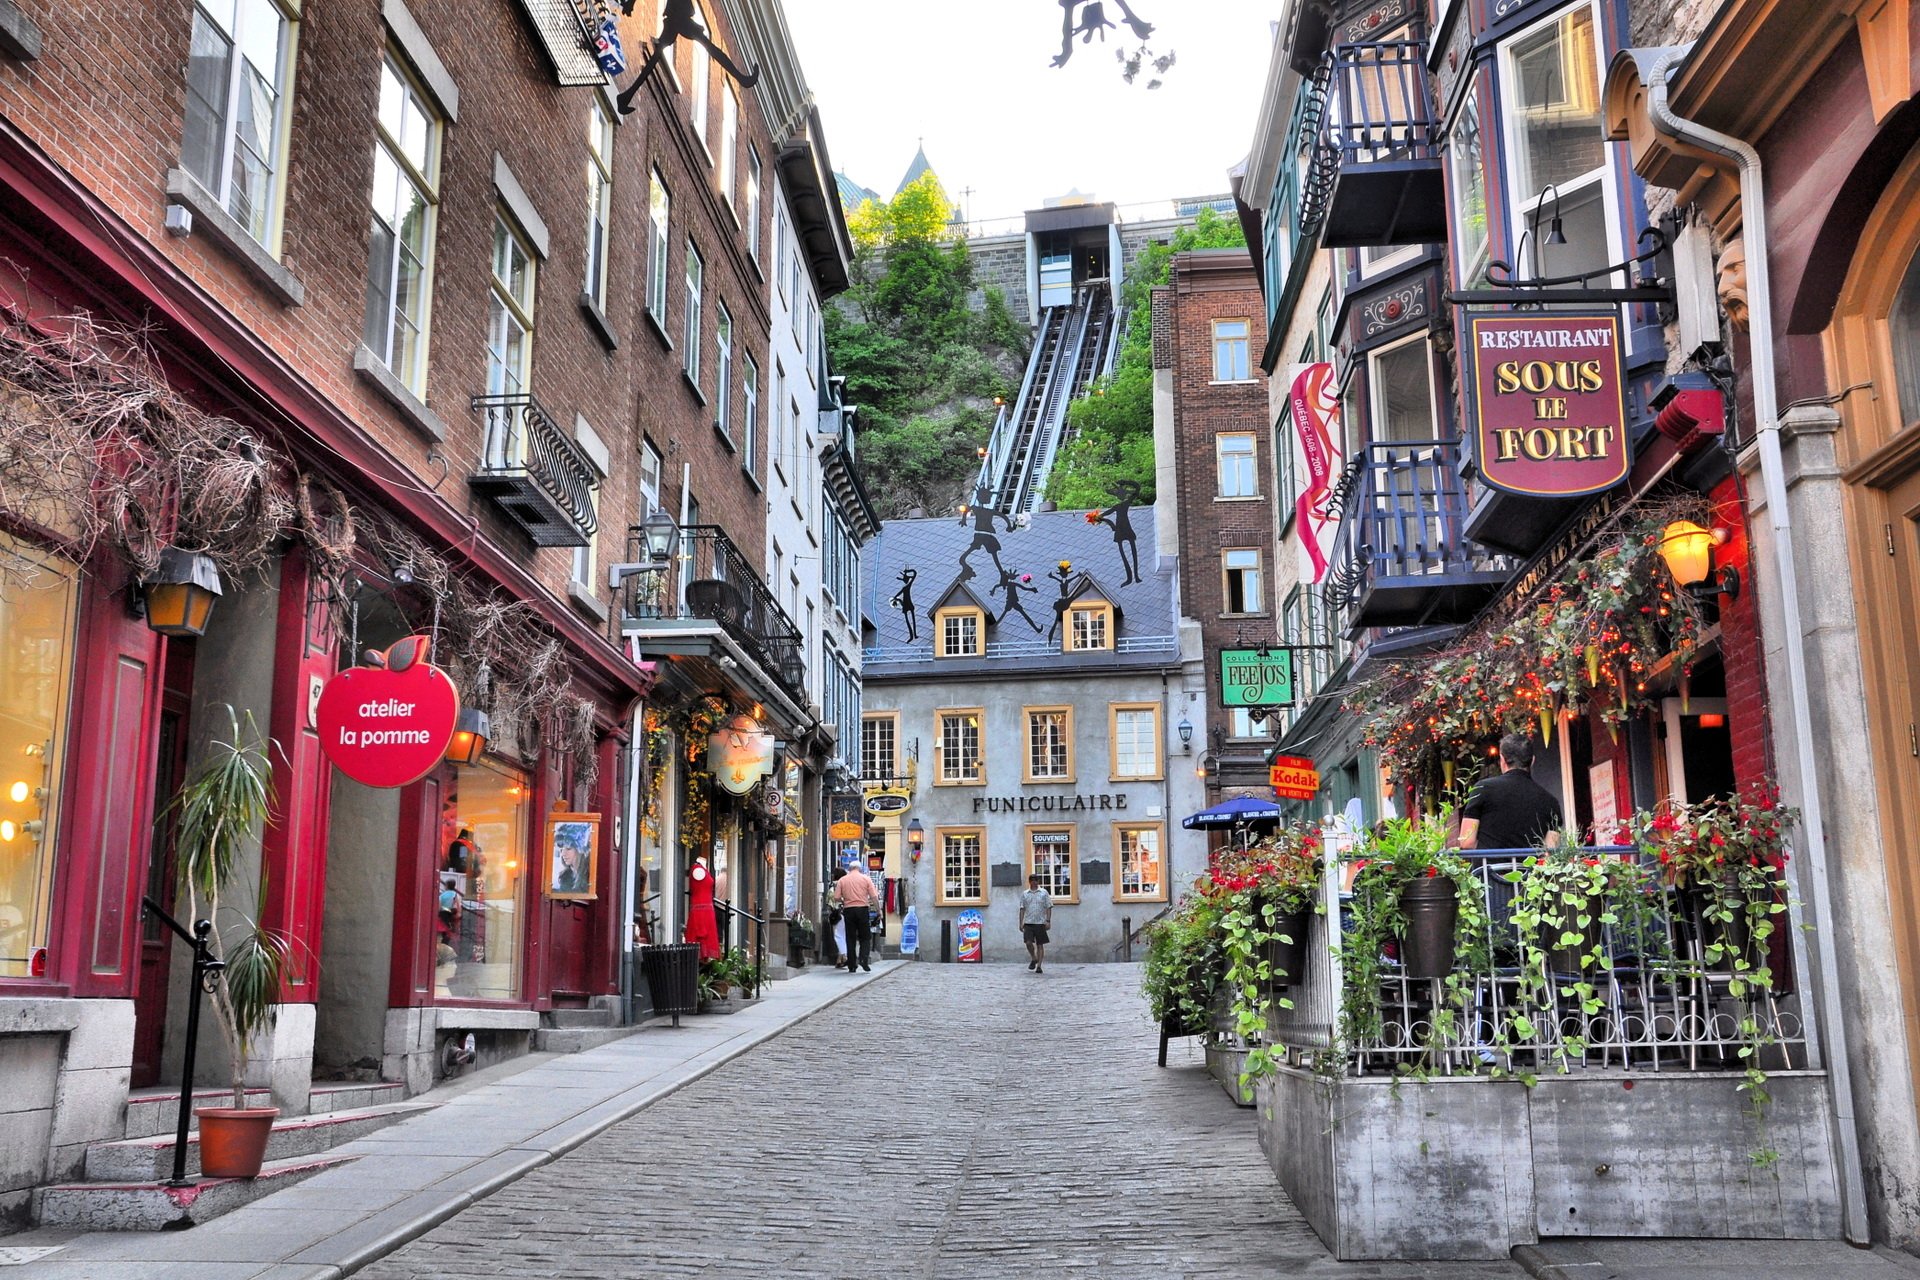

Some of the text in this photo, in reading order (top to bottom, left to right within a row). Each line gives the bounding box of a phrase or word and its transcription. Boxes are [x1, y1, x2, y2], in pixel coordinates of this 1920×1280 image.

[1479, 328, 1611, 349] RESTAURANT
[1495, 360, 1603, 395] SOUS
[1295, 398, 1311, 432] QUÉBEC
[1532, 397, 1568, 420] LE
[1492, 425, 1613, 462] FORT
[359, 698, 415, 718] atelier
[340, 726, 430, 748] la pomme
[1273, 769, 1317, 787] Kodak
[973, 794, 1127, 813] FUNICULAIRE
